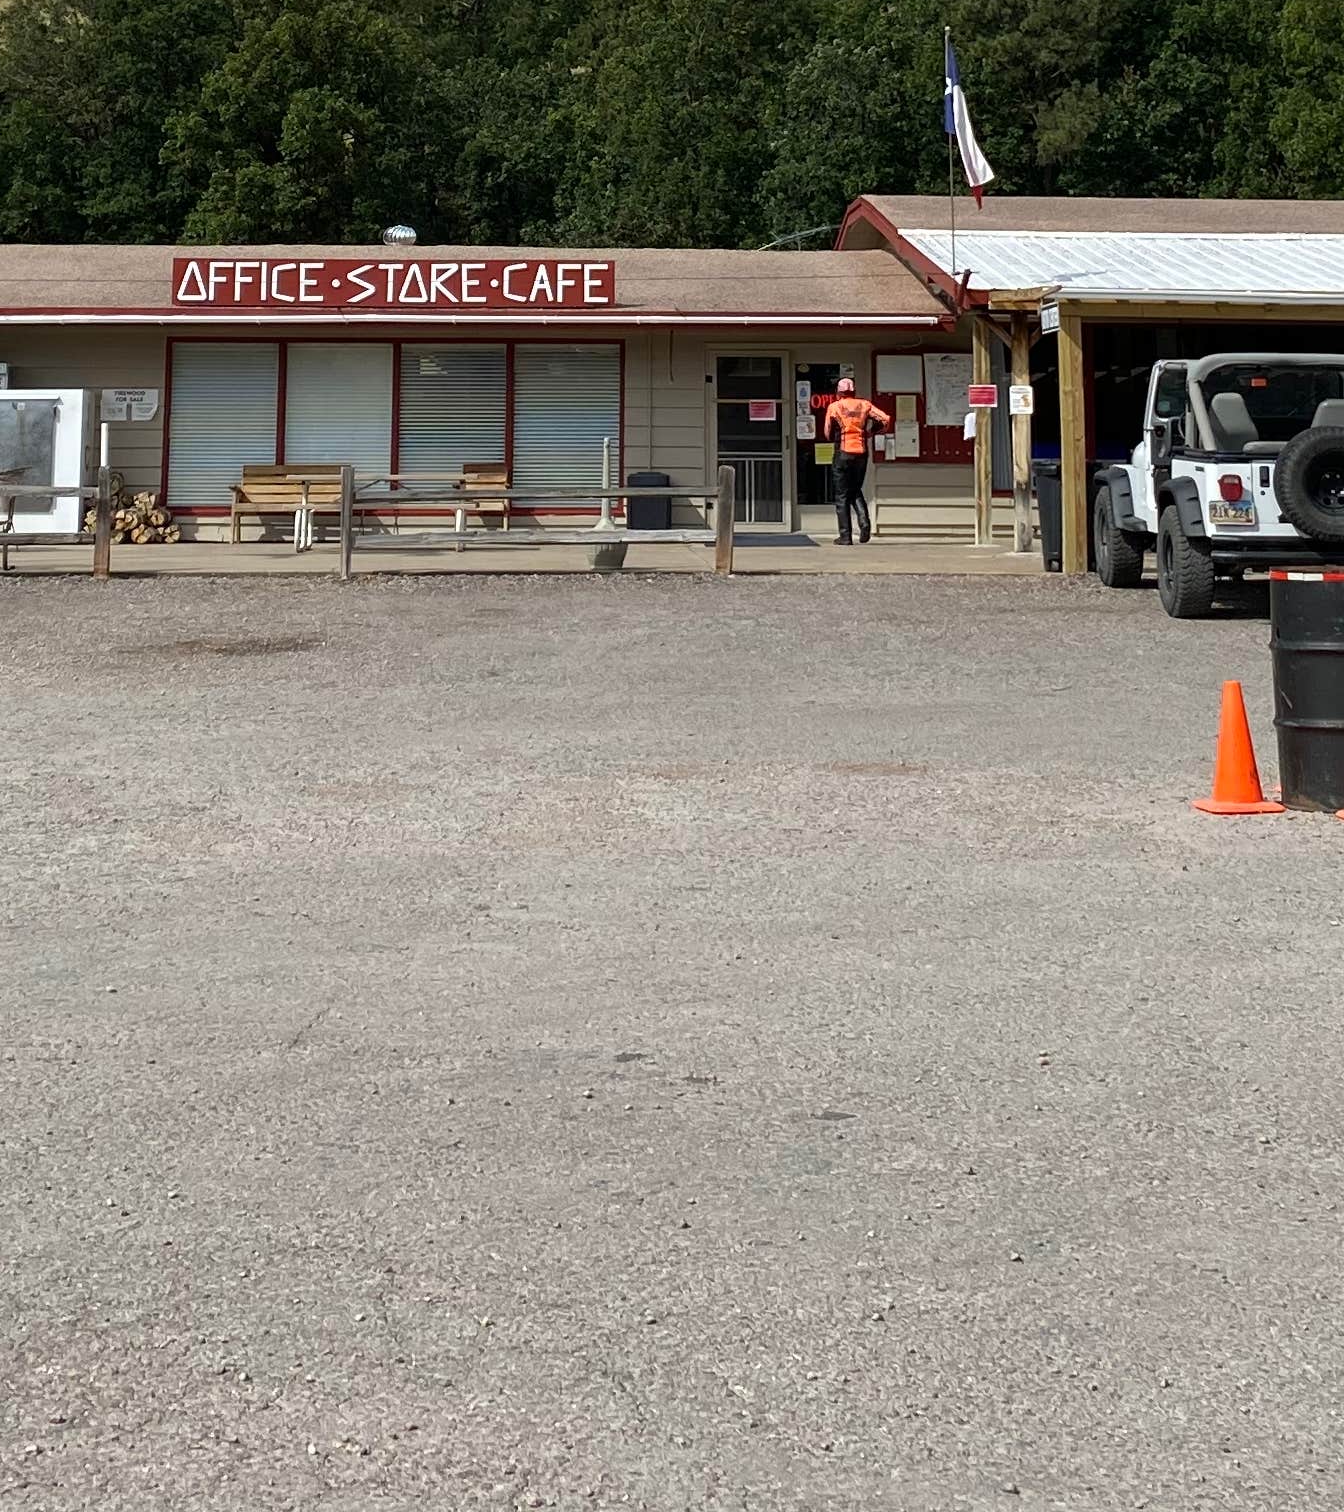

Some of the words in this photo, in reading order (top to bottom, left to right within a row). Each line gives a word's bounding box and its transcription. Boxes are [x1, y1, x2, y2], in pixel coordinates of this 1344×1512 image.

[177, 261, 324, 302] OFFICE
[503, 263, 609, 303] CAFE
[811, 393, 840, 410] OPE
